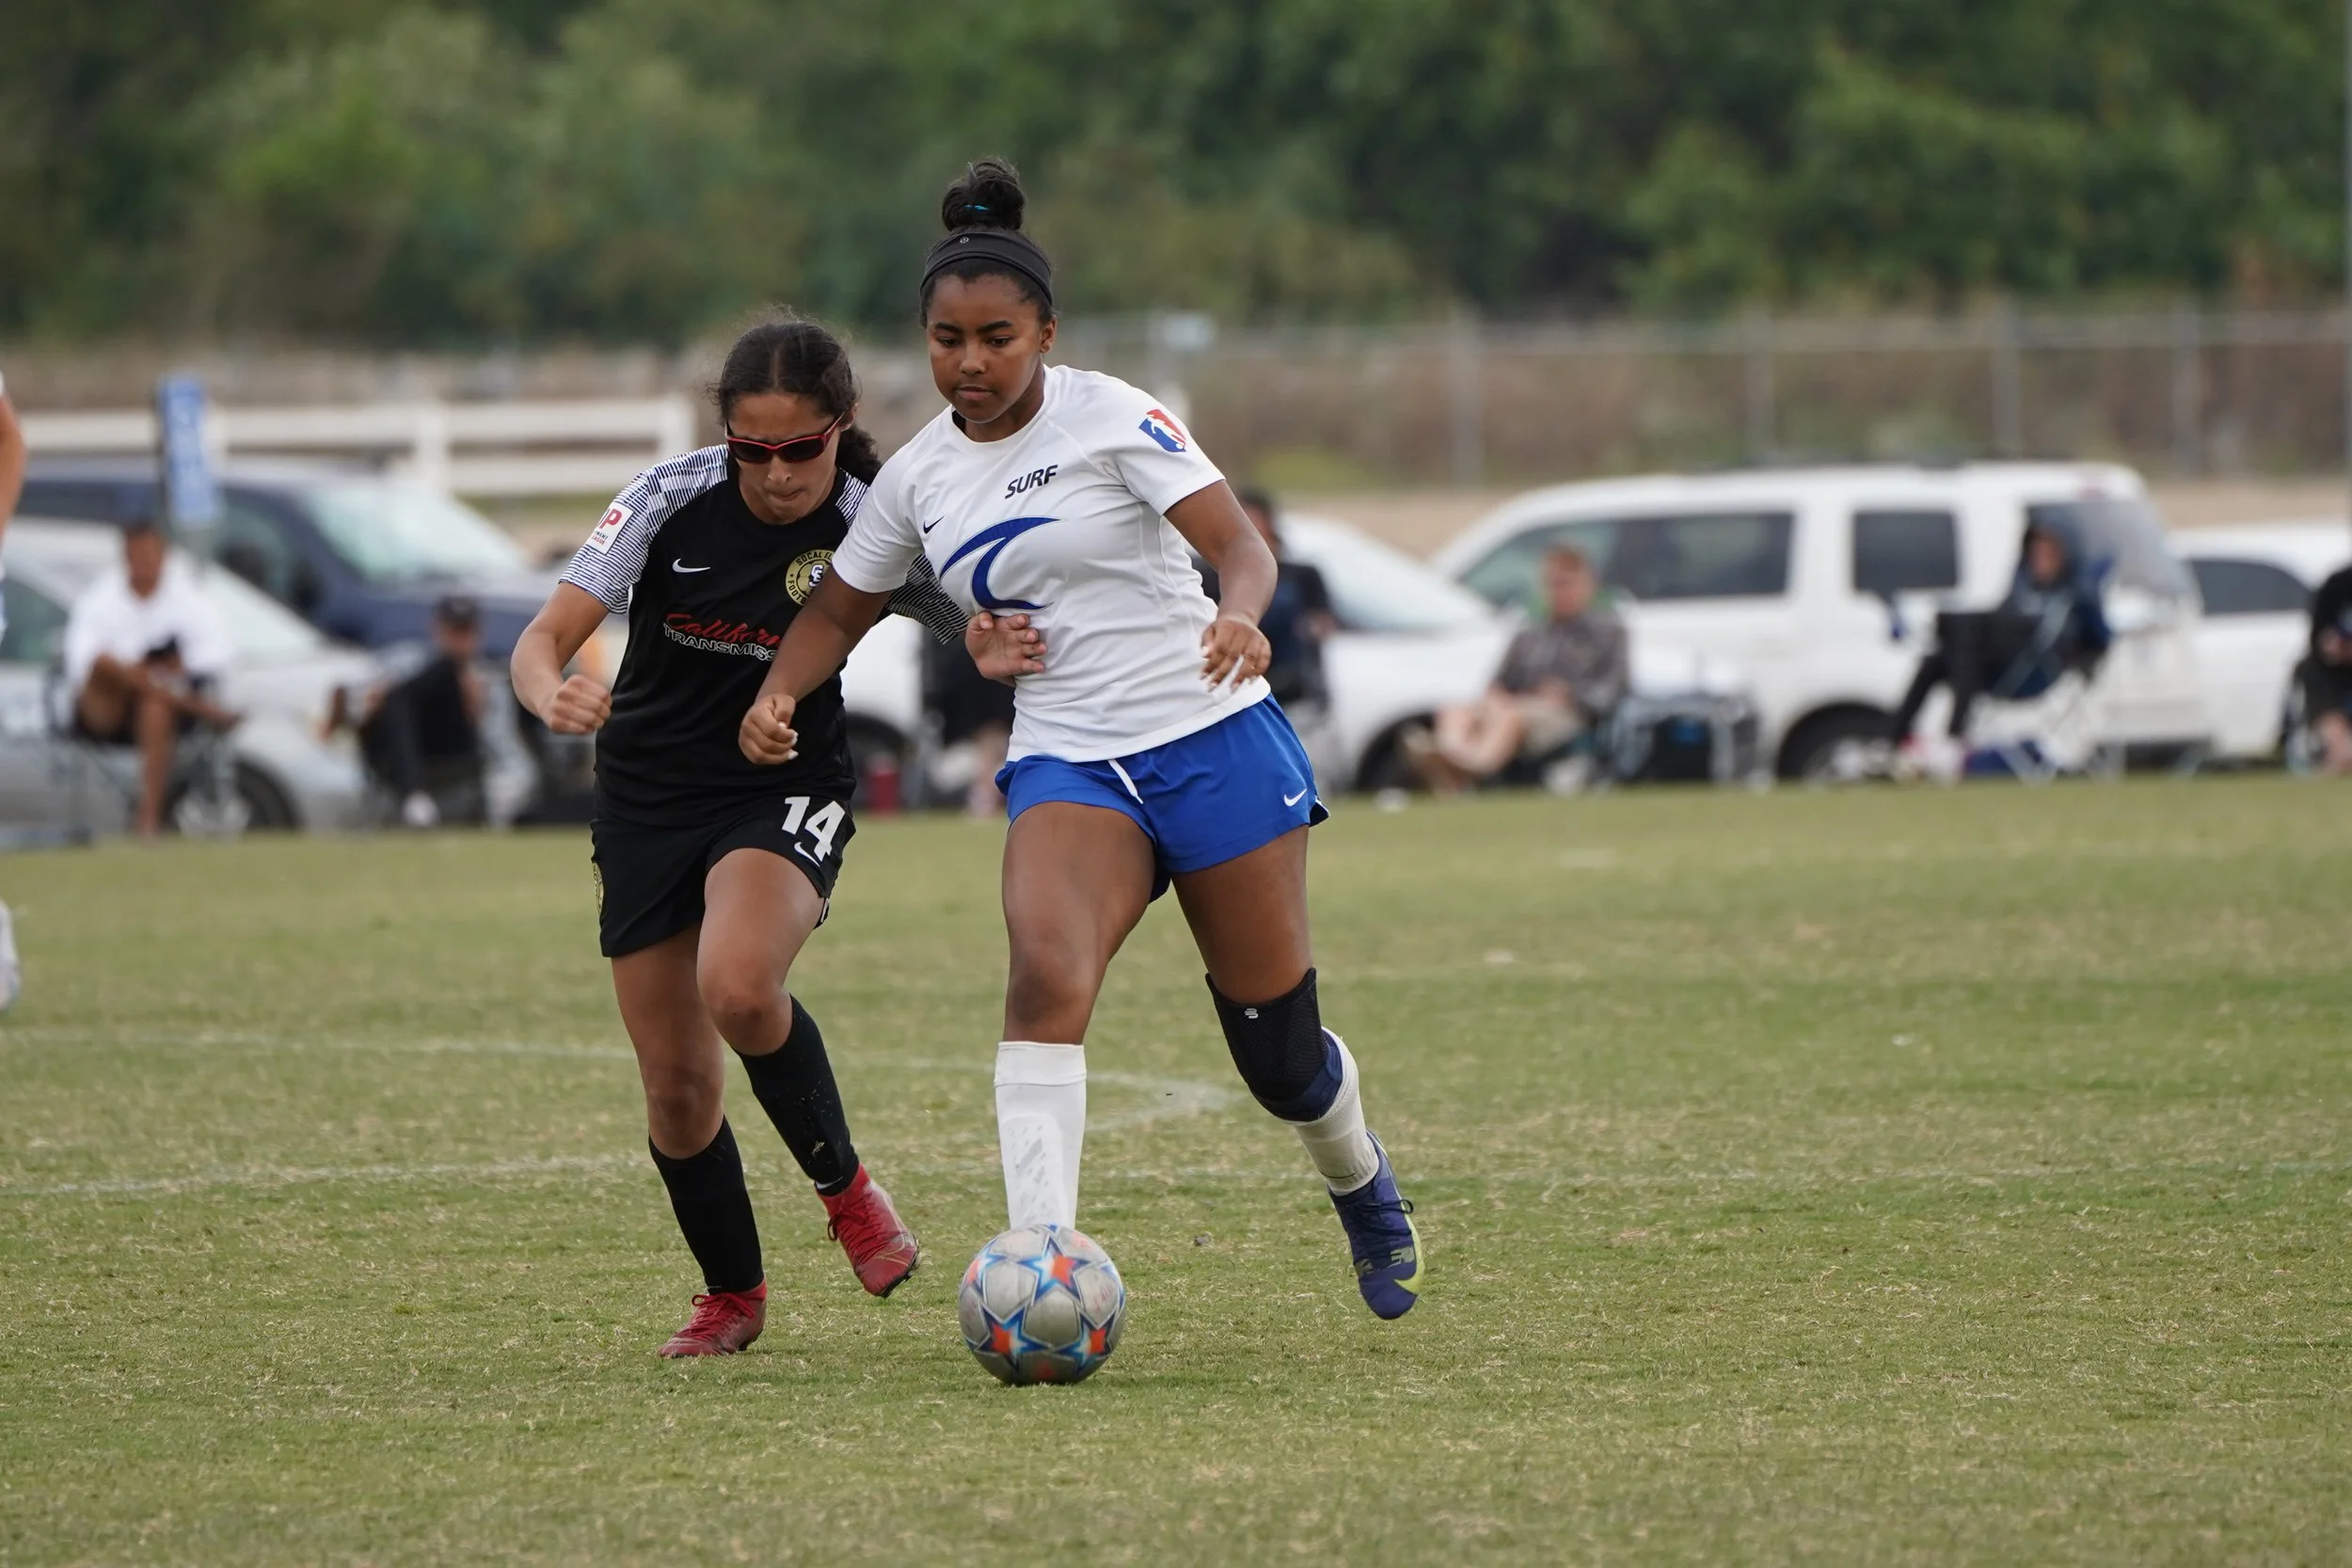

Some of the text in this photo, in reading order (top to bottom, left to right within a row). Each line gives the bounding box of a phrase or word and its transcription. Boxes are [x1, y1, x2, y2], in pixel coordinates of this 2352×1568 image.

[1005, 464, 1058, 499] SURF
[796, 551, 822, 565] SOCAL
[782, 796, 846, 863] 14
